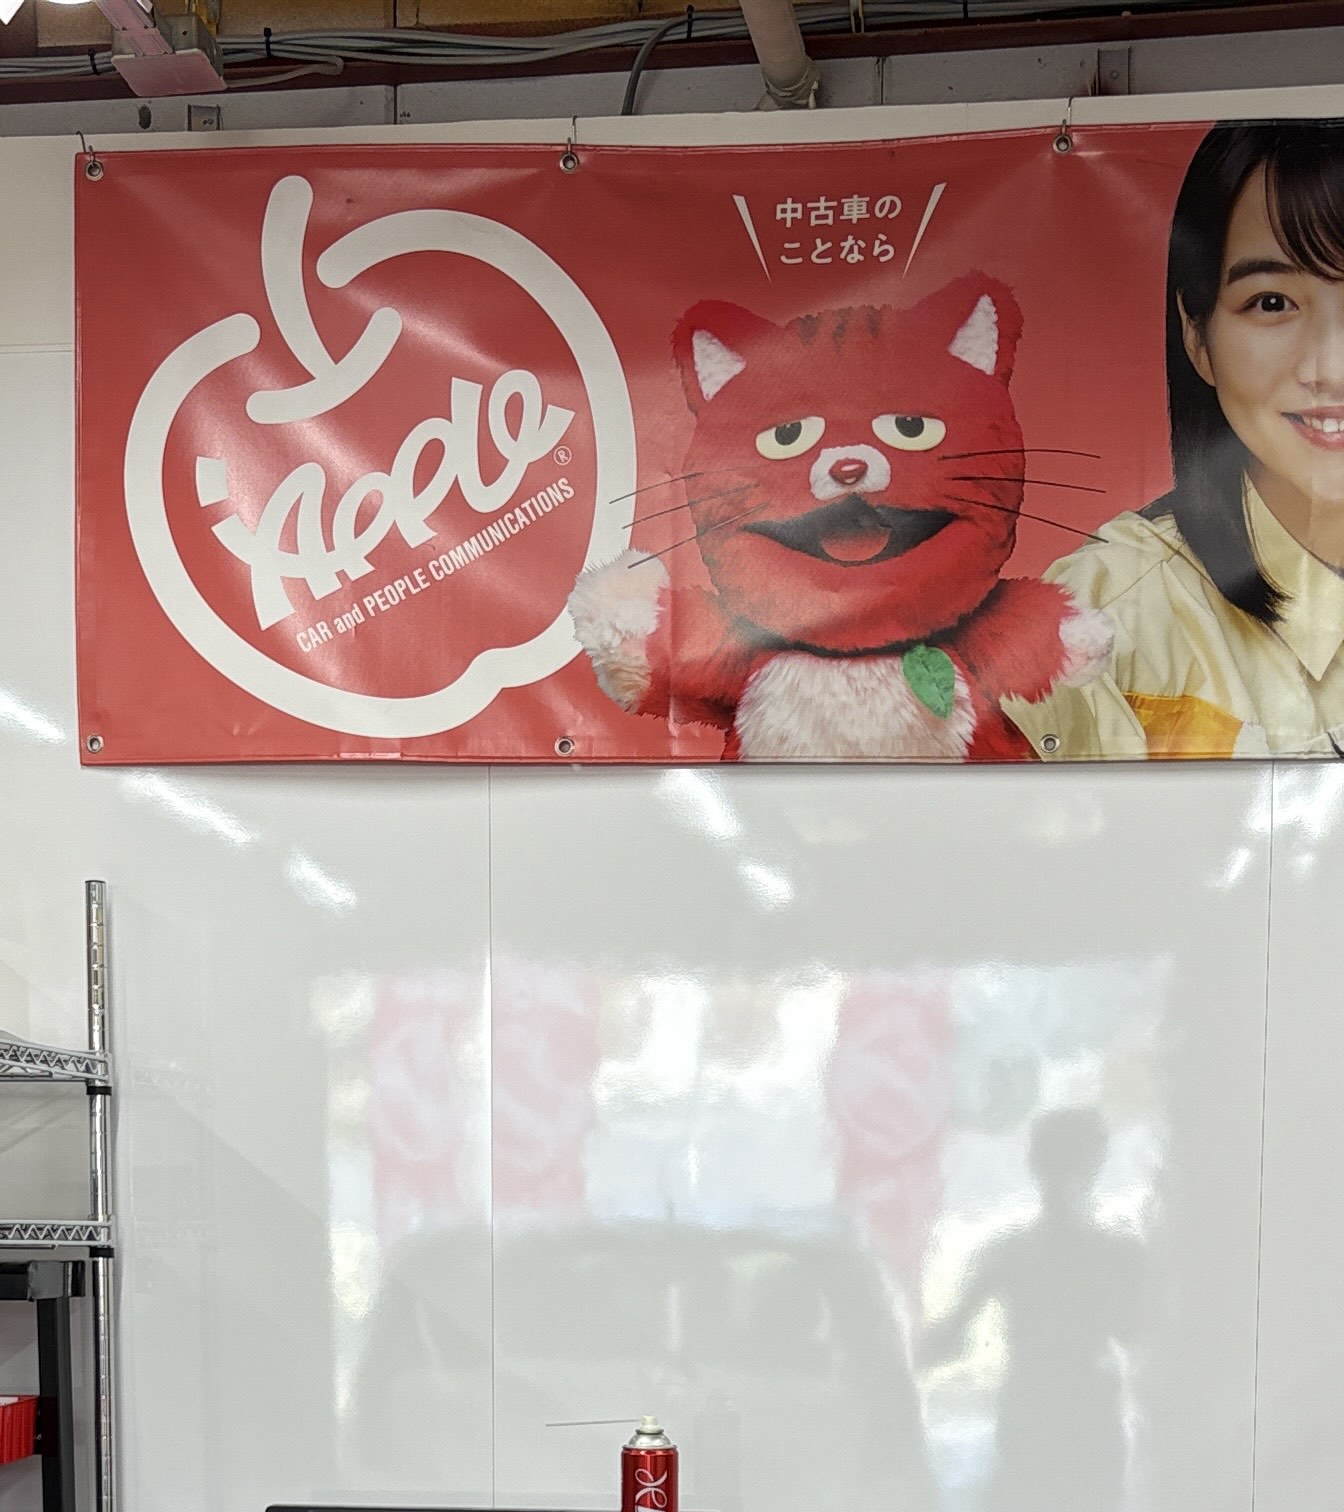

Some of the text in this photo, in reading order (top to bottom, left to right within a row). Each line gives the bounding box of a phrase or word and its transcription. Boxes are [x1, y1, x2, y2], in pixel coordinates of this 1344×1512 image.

[775, 195, 902, 228] 中古車の
[780, 233, 895, 264] ことなら
[296, 477, 575, 652] CAR and PEOPLE COMMUNICATIONS
